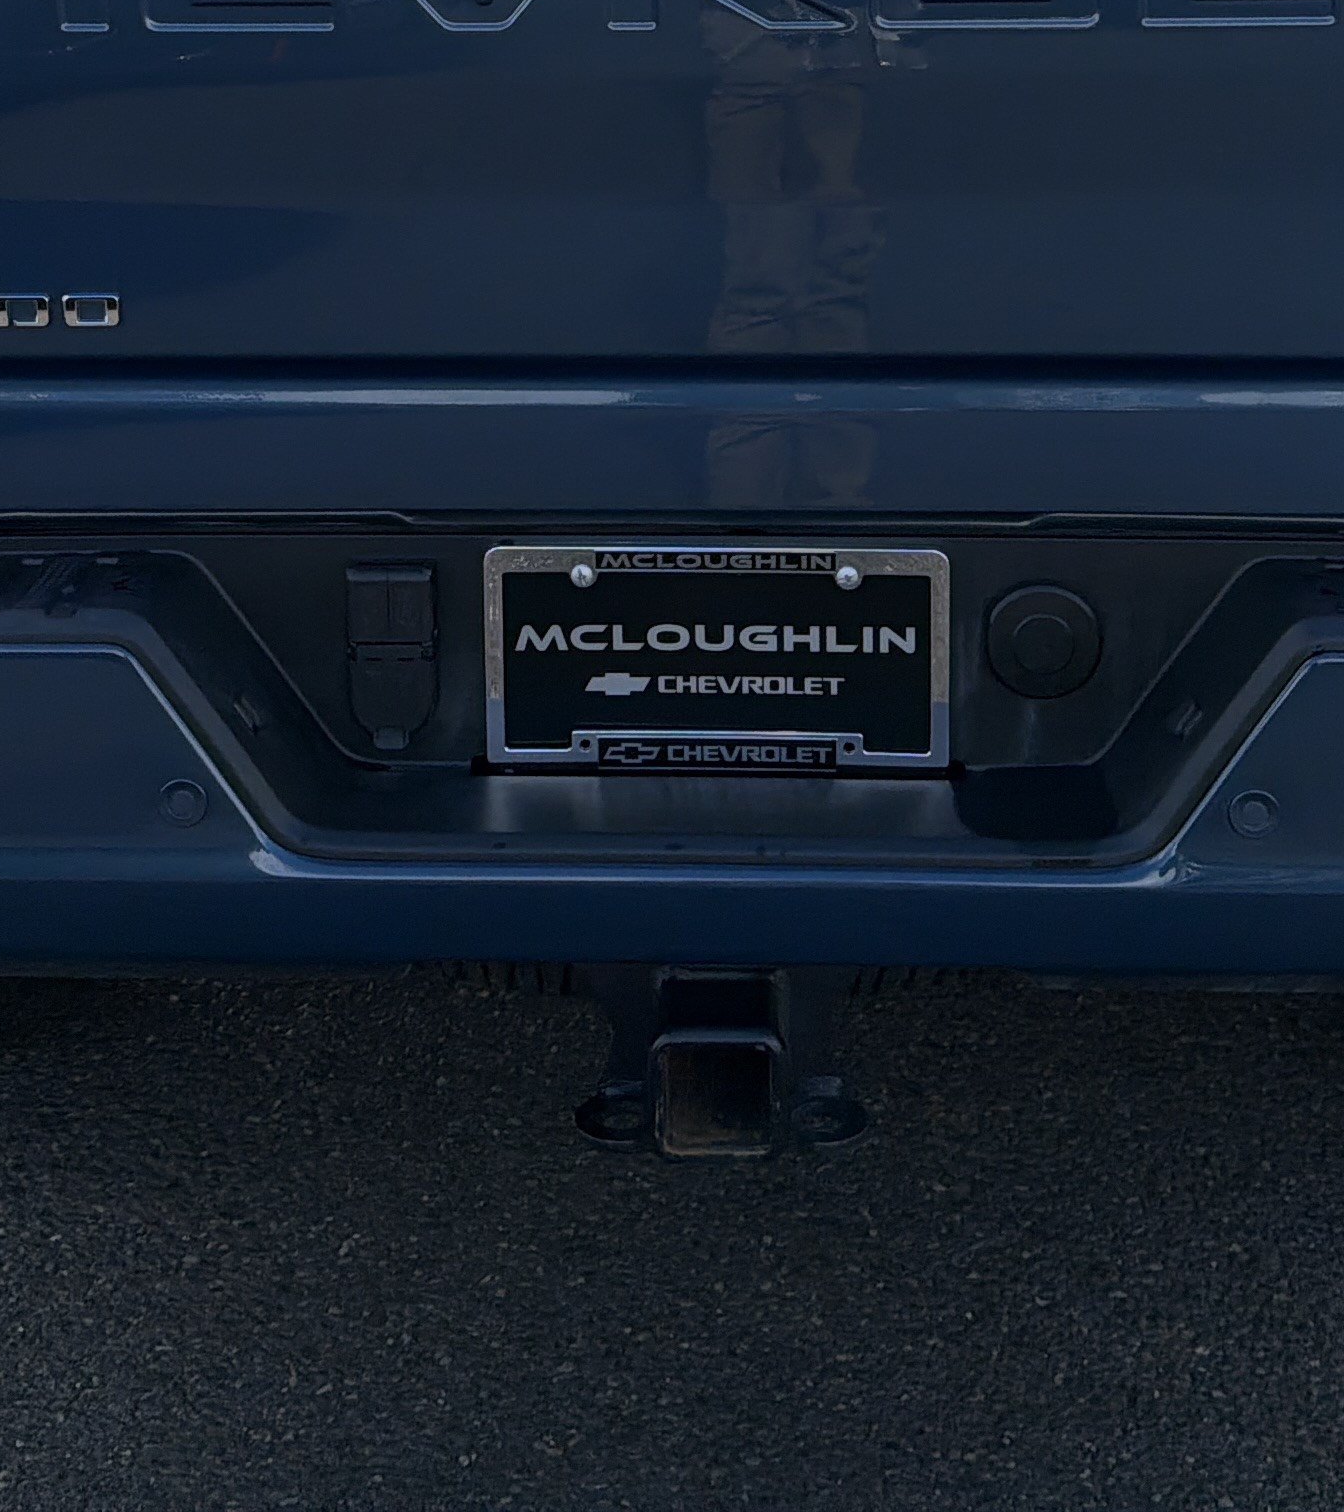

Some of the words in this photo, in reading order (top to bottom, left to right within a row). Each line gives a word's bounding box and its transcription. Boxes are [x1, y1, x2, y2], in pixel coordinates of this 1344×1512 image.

[600, 552, 833, 570] MCLOUGHLIN
[514, 623, 917, 654] MCLOUGHLIN
[657, 674, 846, 696] CHEVROLET
[666, 745, 833, 765] CHEVROLET
